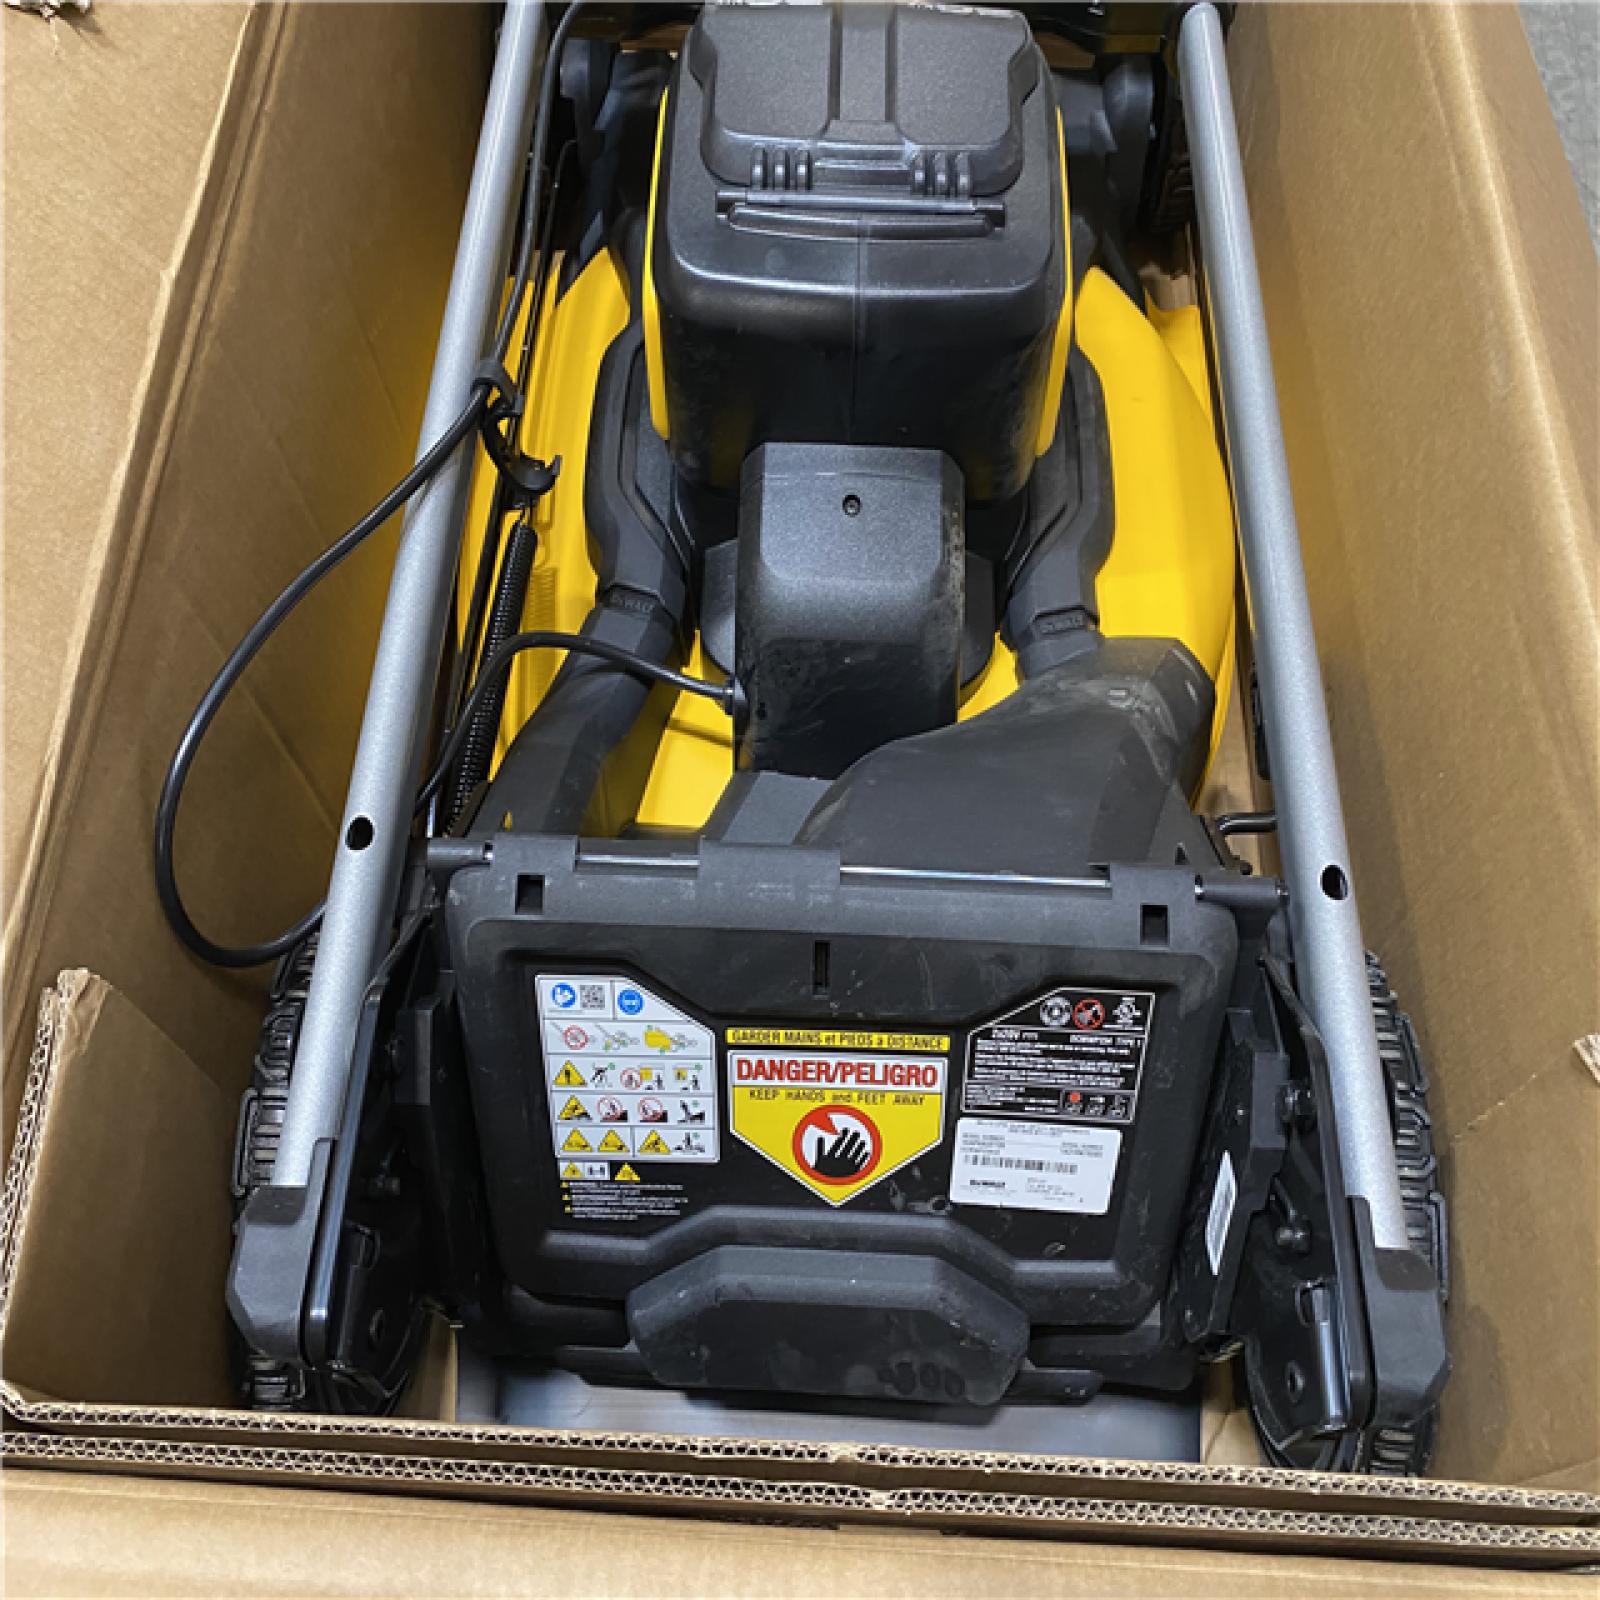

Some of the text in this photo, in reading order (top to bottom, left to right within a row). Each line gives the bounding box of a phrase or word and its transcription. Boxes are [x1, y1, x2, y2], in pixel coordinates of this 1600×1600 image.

[784, 1031, 822, 1044] MAINS
[839, 1033, 872, 1047] PIEDS
[887, 1034, 944, 1050] DISTANCE
[736, 1058, 938, 1088] DANGER/PELIGRO
[749, 1087, 781, 1100] KEEP
[784, 1089, 826, 1102] HANDS
[856, 1091, 887, 1105] FEET
[892, 1094, 926, 1106] AWAY
